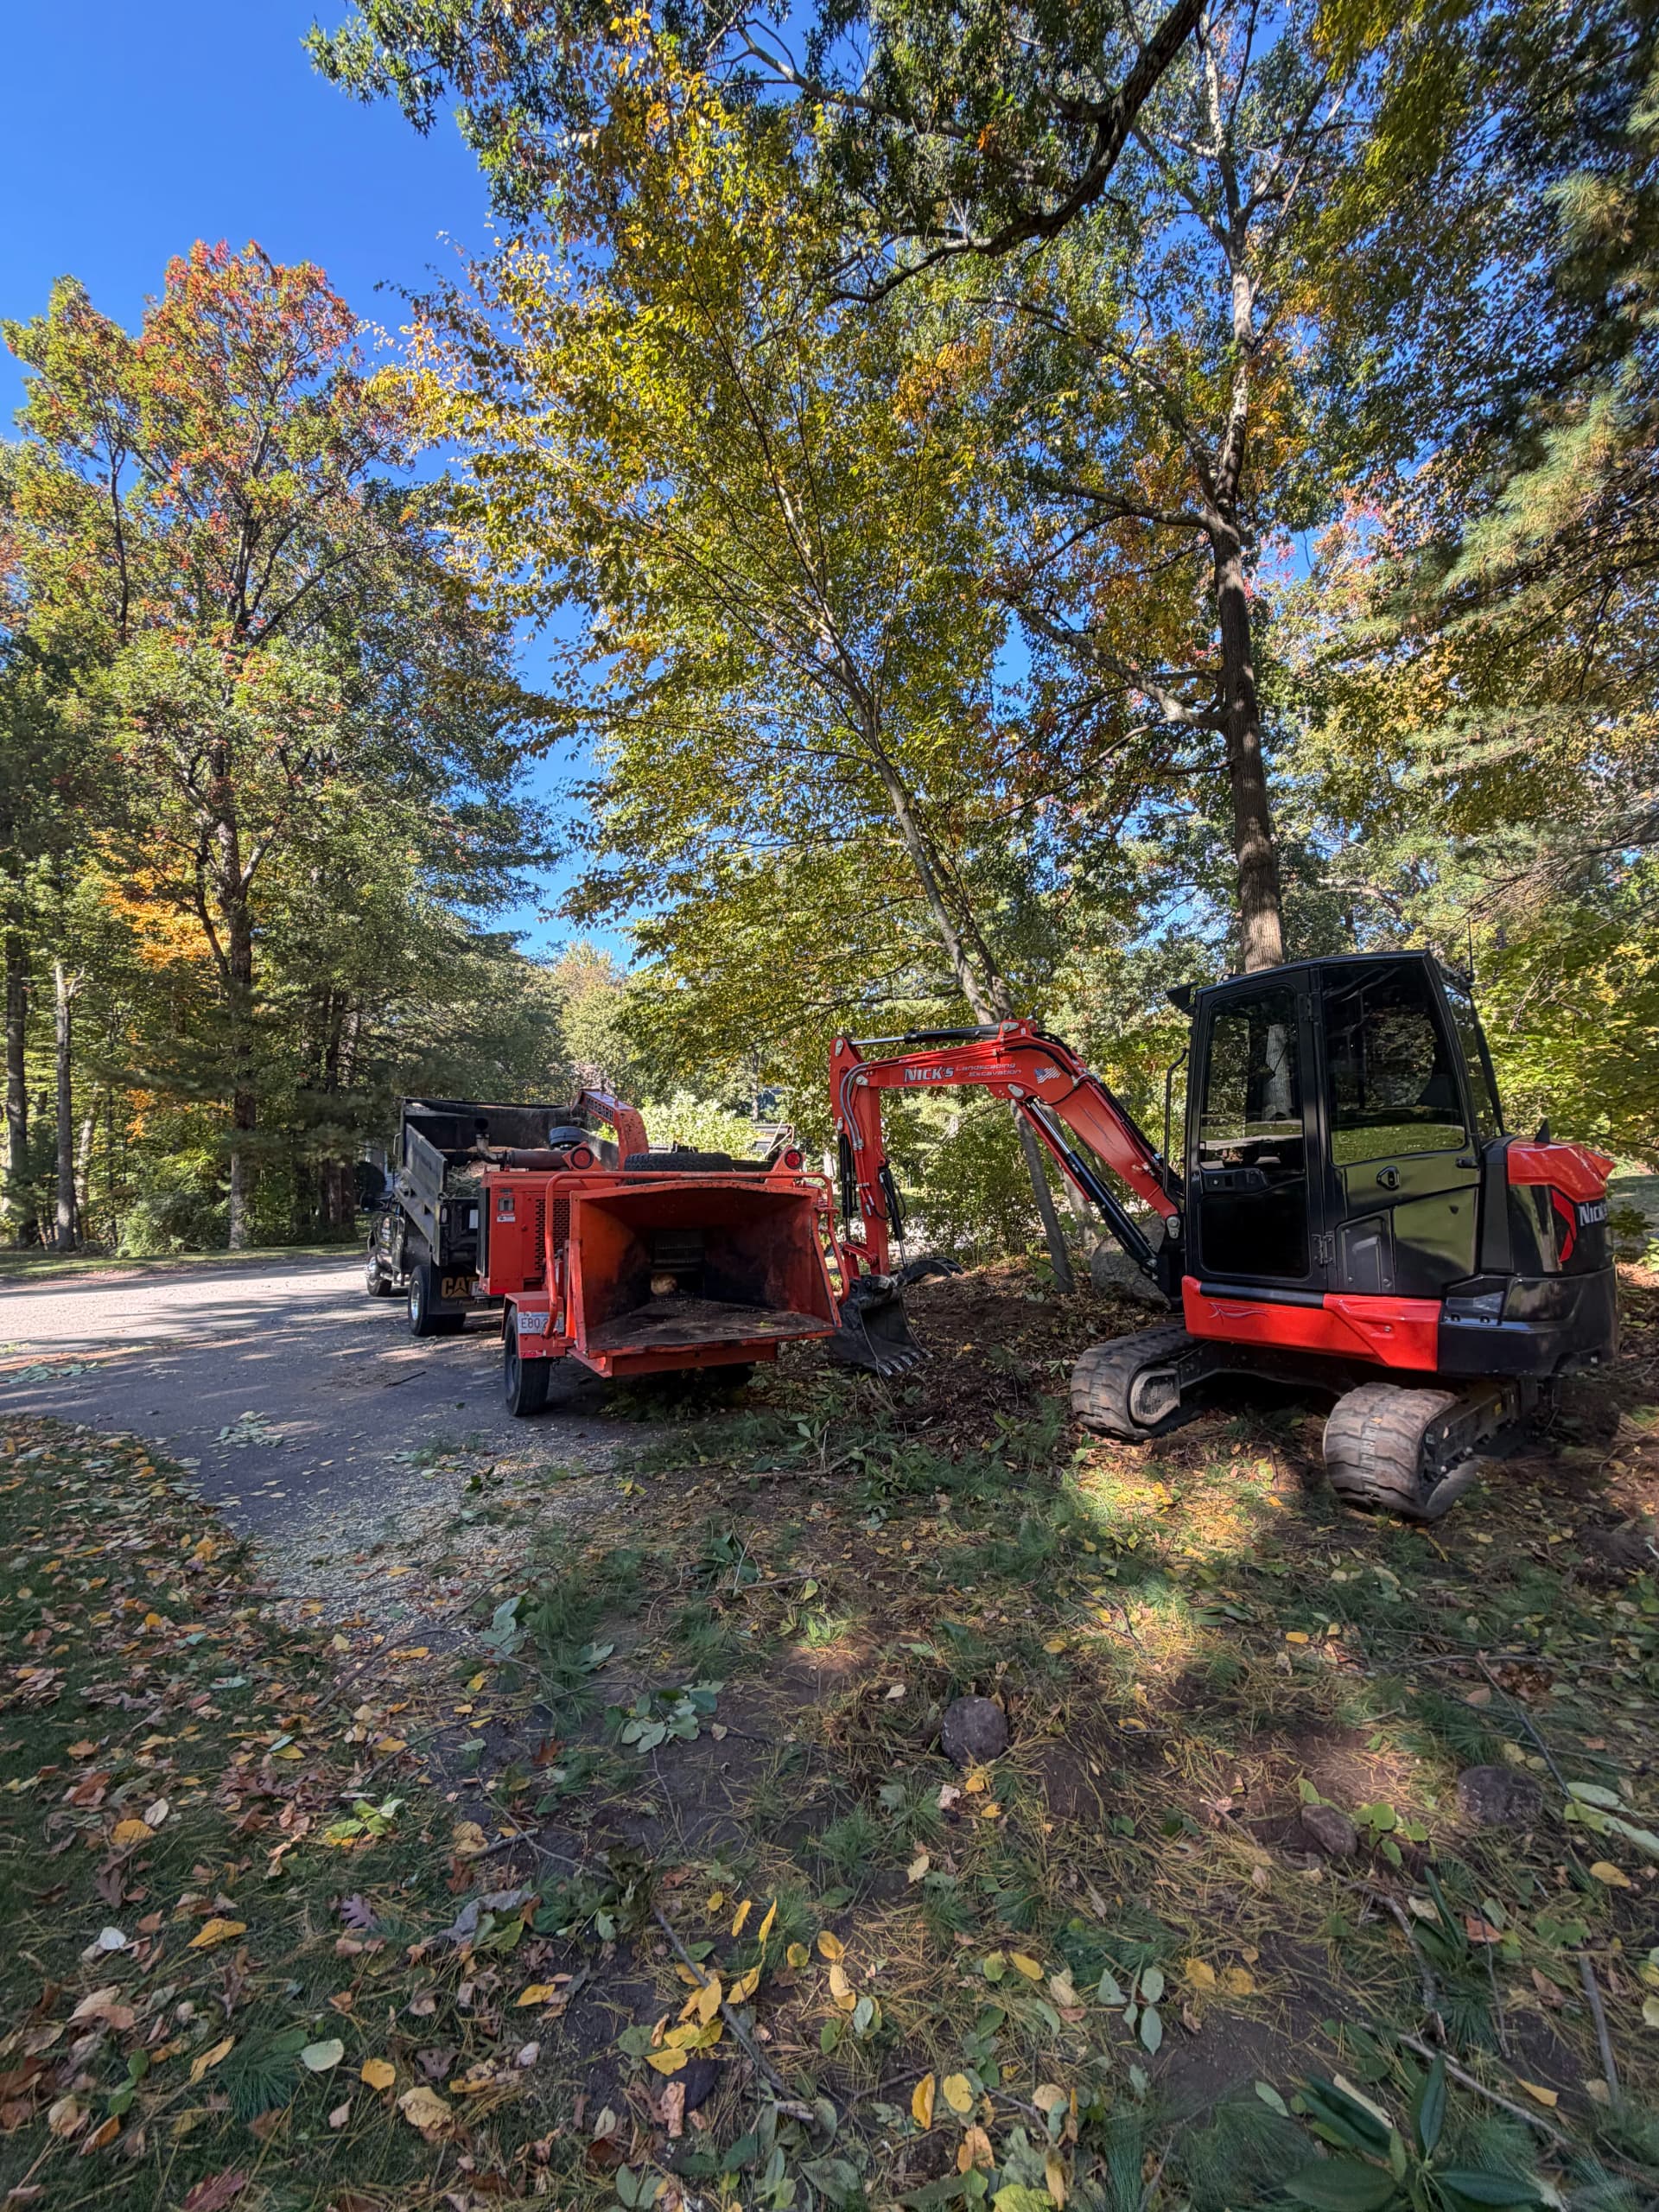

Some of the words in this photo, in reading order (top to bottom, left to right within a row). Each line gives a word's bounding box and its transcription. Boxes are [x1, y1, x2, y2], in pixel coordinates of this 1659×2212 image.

[956, 1063, 1016, 1071] Landscaping
[904, 1065, 955, 1083] NICK'S
[968, 1069, 1022, 1077] Excavation
